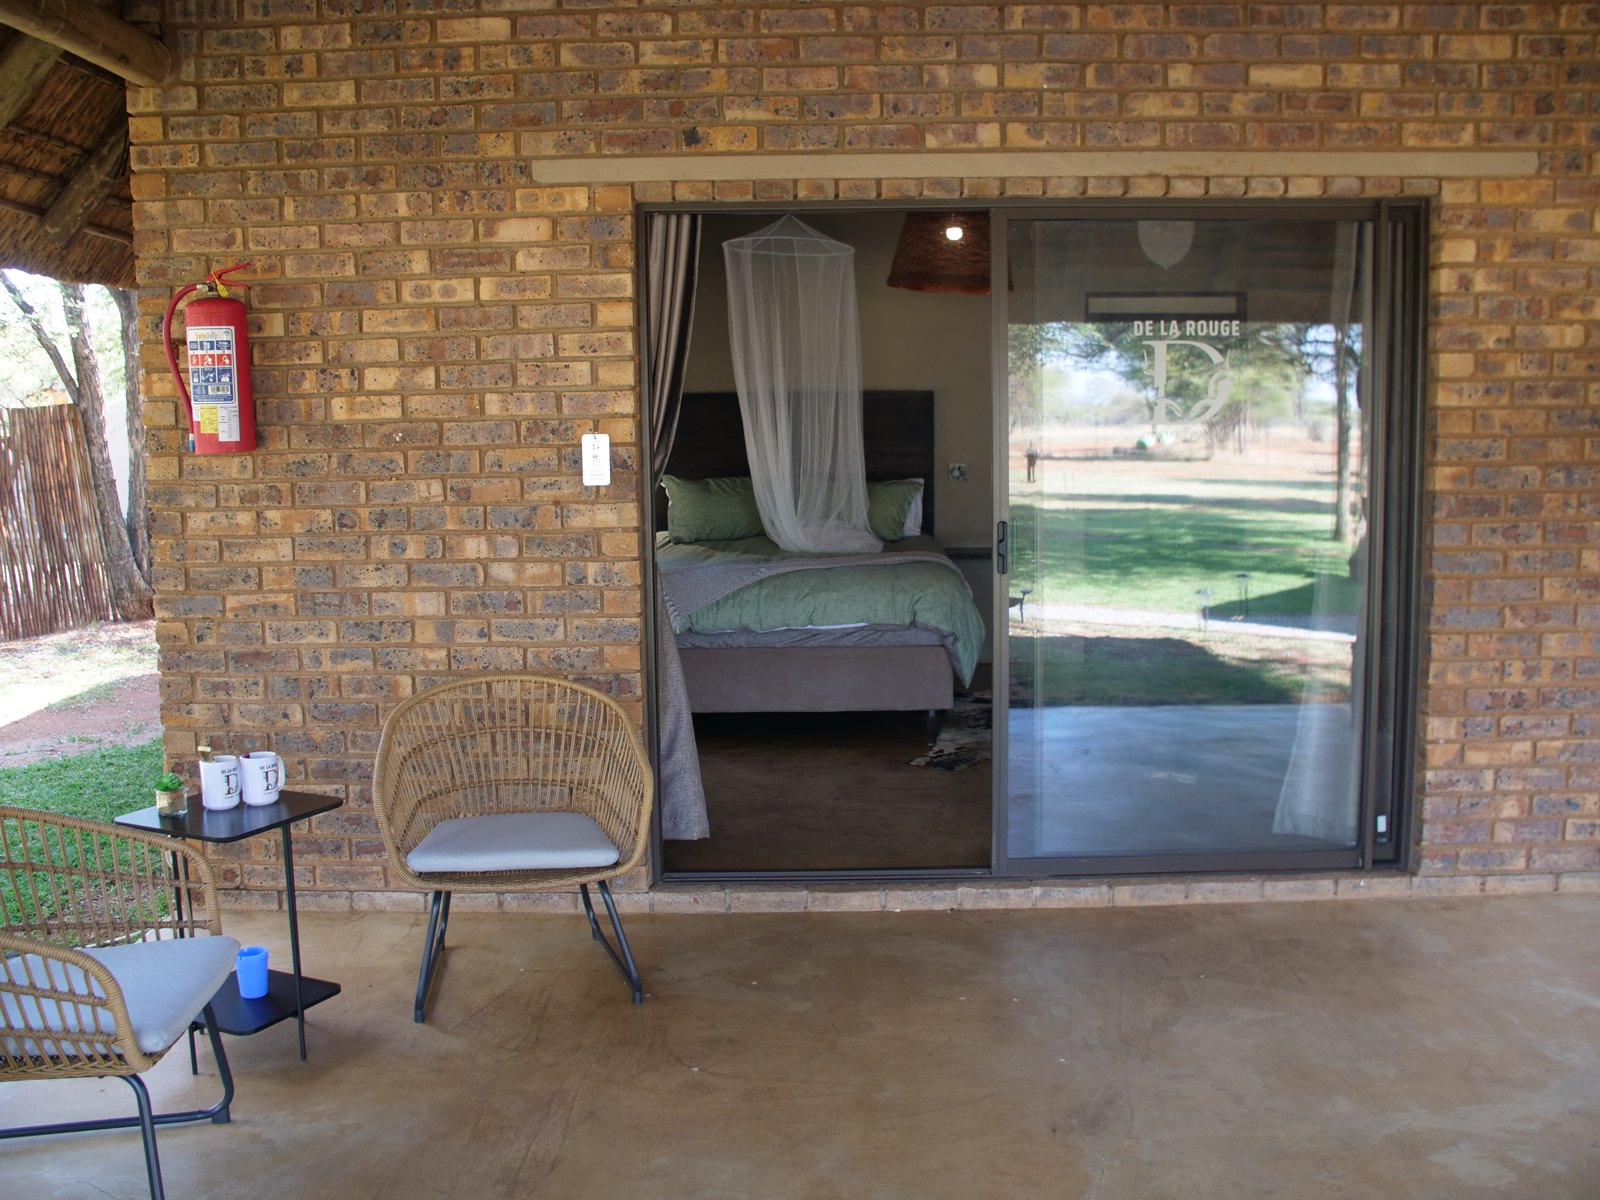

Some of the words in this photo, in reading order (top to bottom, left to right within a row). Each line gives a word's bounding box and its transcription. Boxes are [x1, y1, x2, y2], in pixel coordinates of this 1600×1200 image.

[1134, 320, 1153, 336] DE
[1160, 320, 1179, 336] LA
[1186, 320, 1240, 336] ROUGE
